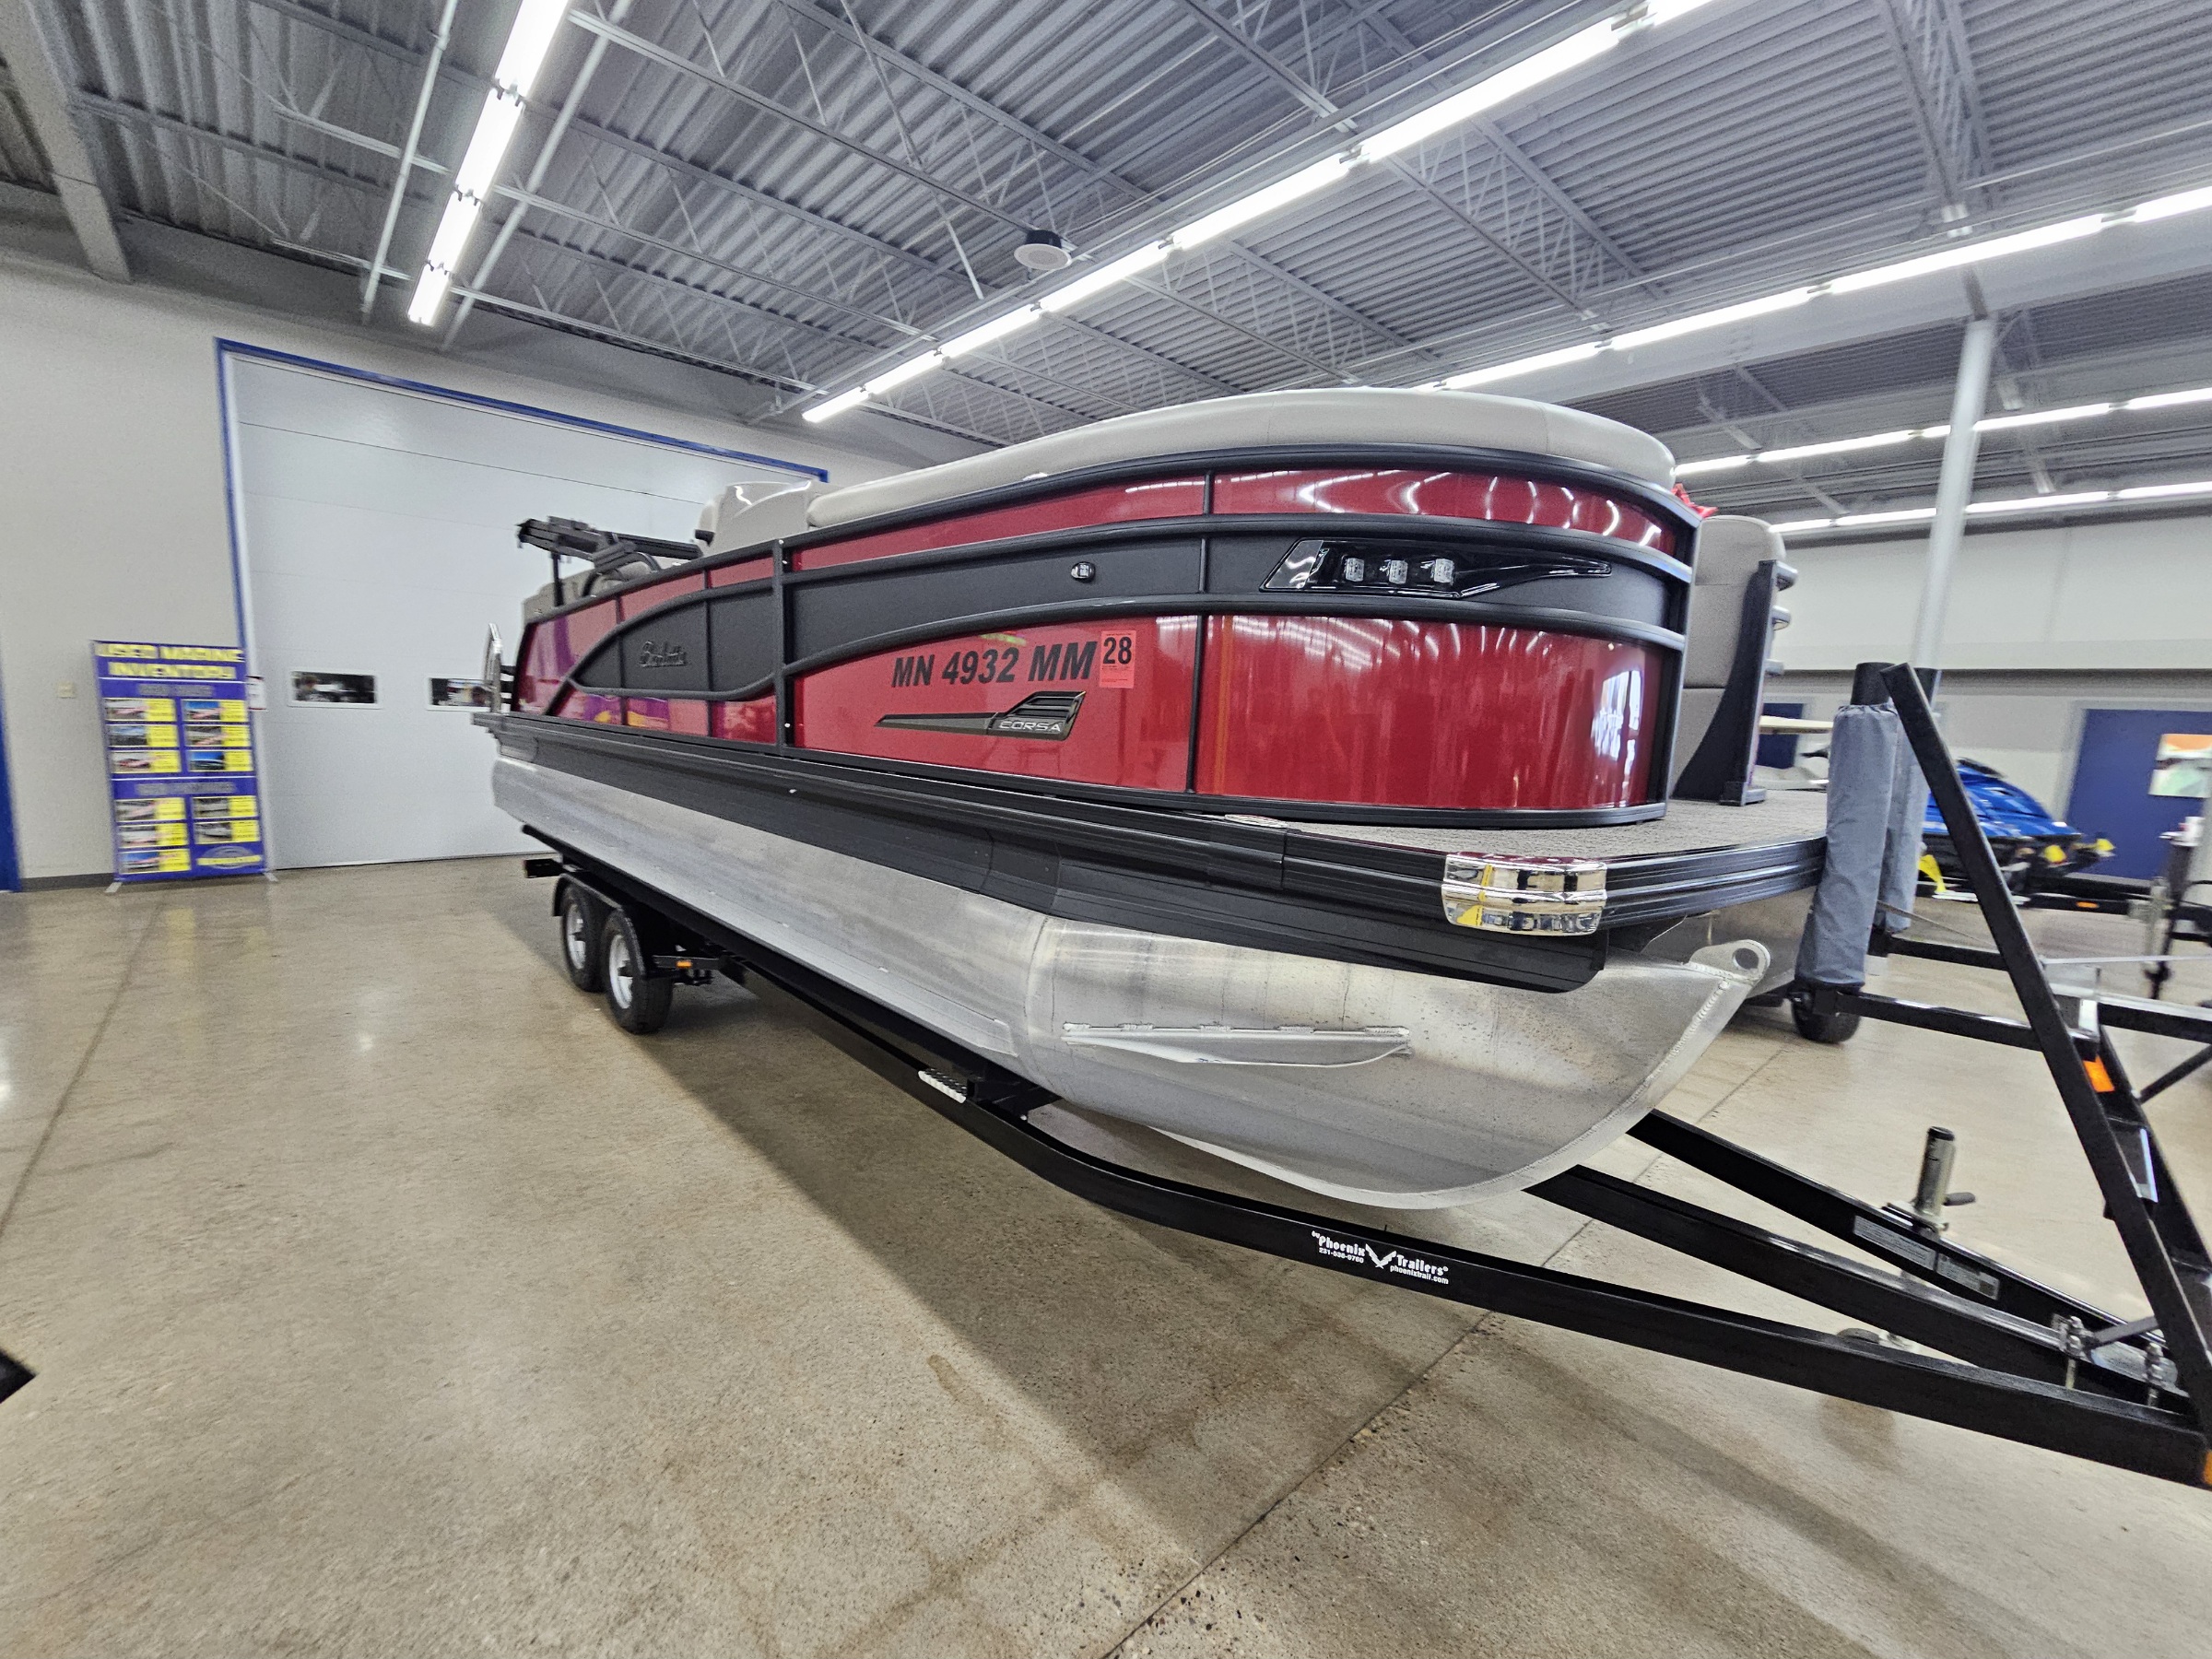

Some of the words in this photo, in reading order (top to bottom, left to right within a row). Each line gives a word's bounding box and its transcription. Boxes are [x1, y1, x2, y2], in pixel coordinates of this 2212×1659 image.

[1102, 636, 1132, 665] 28
[892, 655, 935, 687] MN
[941, 647, 1020, 685] 4932
[1028, 641, 1097, 681] MM
[998, 719, 1063, 733] CORSA
[1318, 1235, 1366, 1256] Phoenix
[1389, 1265, 1450, 1285] phoenixtrail.com
